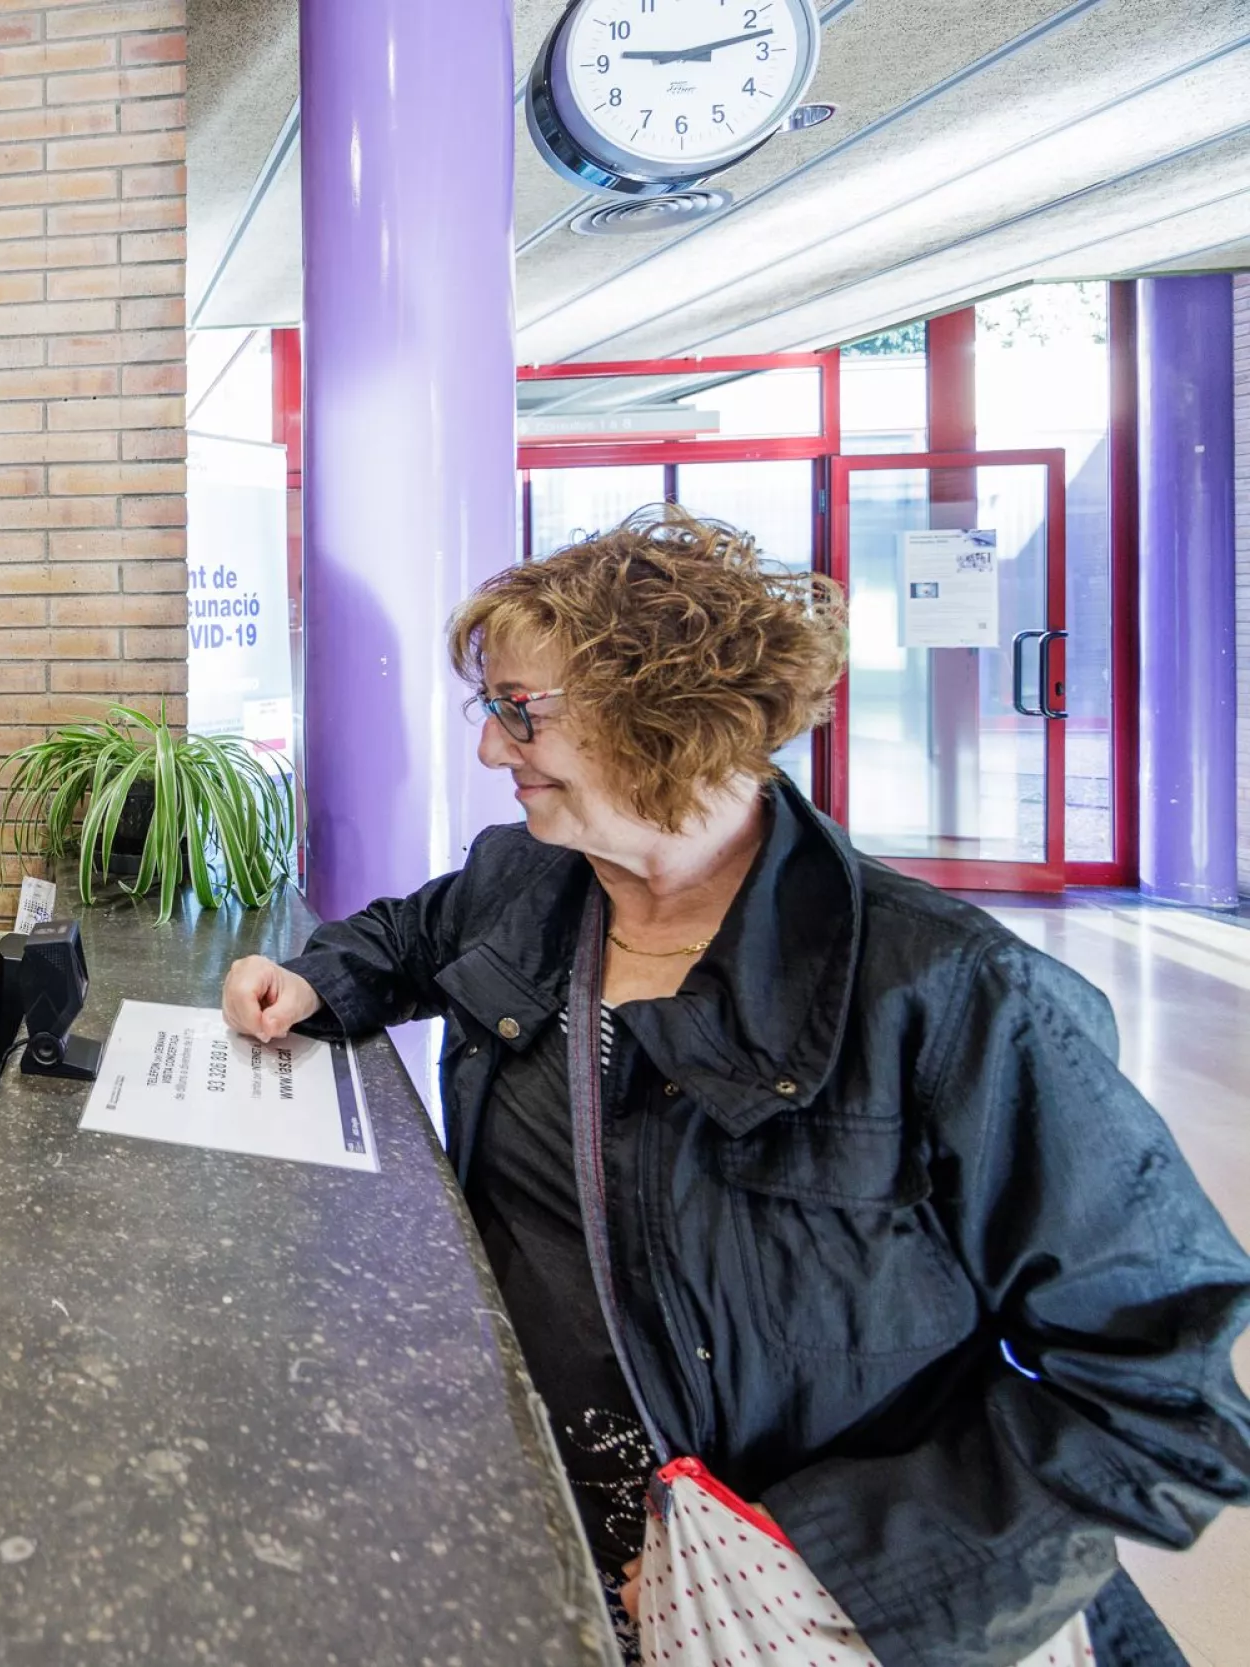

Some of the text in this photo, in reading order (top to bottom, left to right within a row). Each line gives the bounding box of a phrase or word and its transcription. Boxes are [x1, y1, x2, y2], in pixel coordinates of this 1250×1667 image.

[743, 9, 757, 29] 2
[609, 20, 631, 41] 10
[755, 41, 770, 61] 3
[596, 54, 610, 74] 9
[742, 77, 757, 96] 4
[609, 87, 622, 107] 8
[640, 109, 652, 129] 7
[712, 104, 725, 124] 5
[675, 115, 688, 135] 6
[212, 565, 237, 589] de
[206, 1040, 228, 1092] 93 326 89 01
[251, 1048, 262, 1071] INTERNET
[161, 1068, 174, 1084] VISITA
[276, 1048, 294, 1100] www.ias.cat
